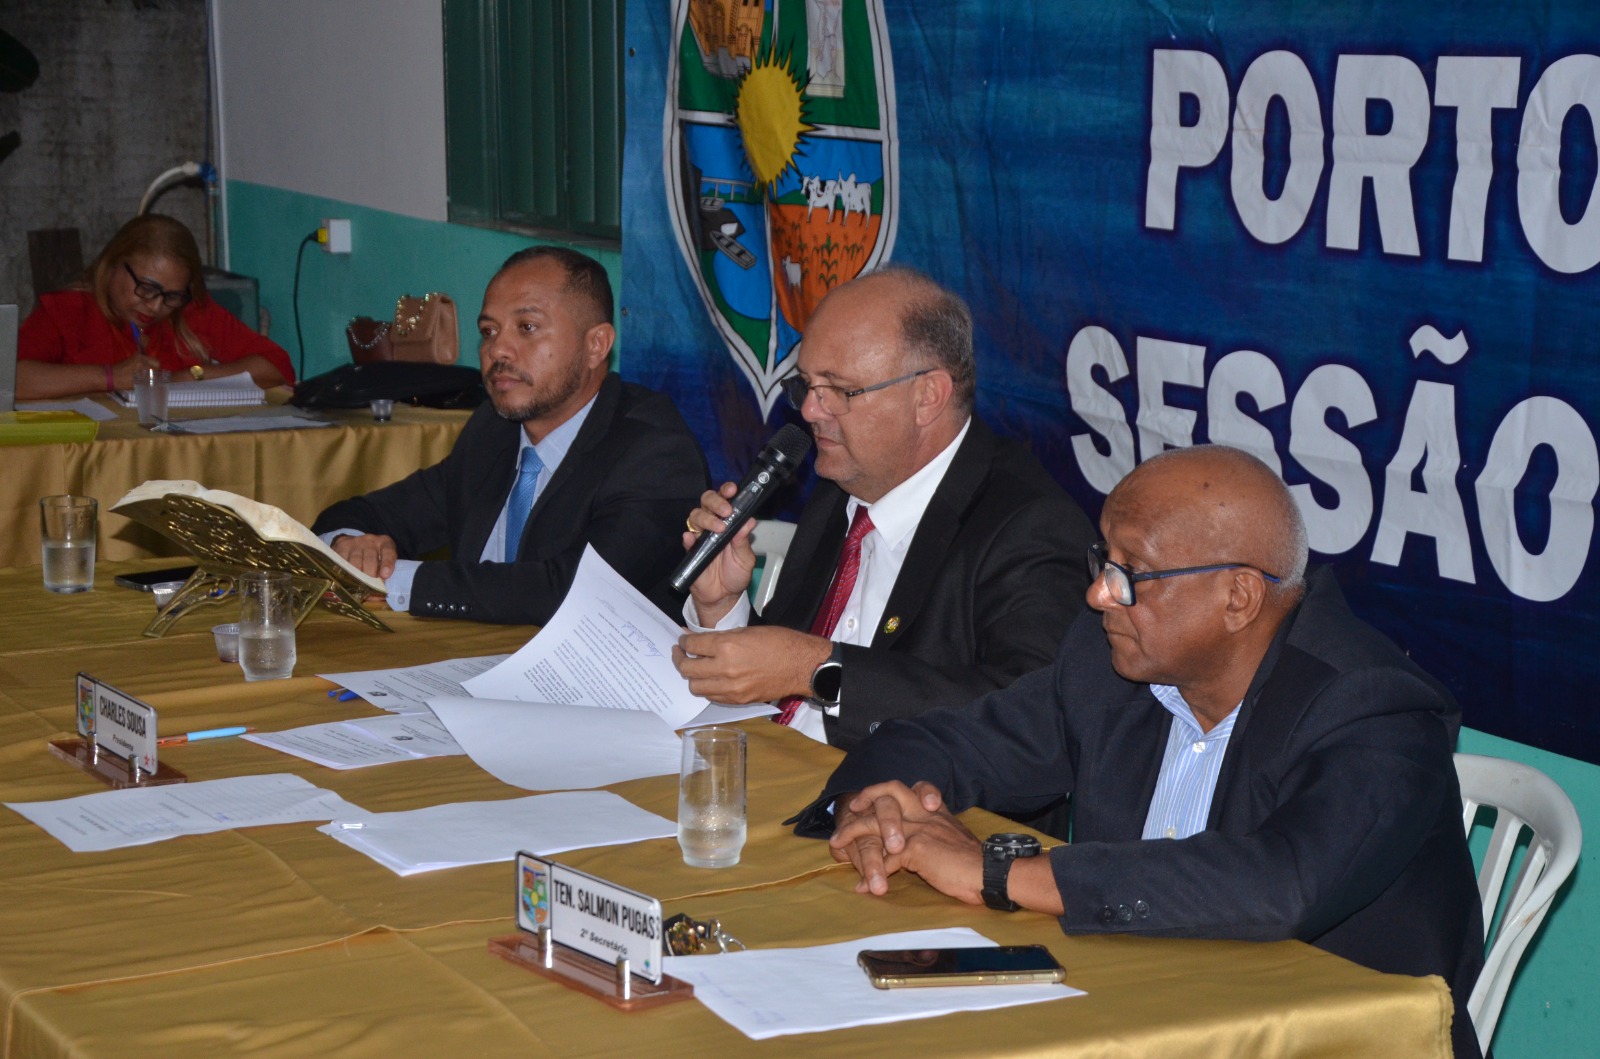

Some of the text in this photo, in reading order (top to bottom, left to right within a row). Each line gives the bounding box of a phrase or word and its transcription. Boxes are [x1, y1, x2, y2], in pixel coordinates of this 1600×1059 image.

[1145, 48, 1600, 274] PORTO
[1066, 325, 1600, 602] SESSÃO
[99, 695, 147, 739] CHARLES SOUSA
[112, 733, 134, 752] Presidente
[553, 879, 655, 940] TEN. SALMON PUGAS
